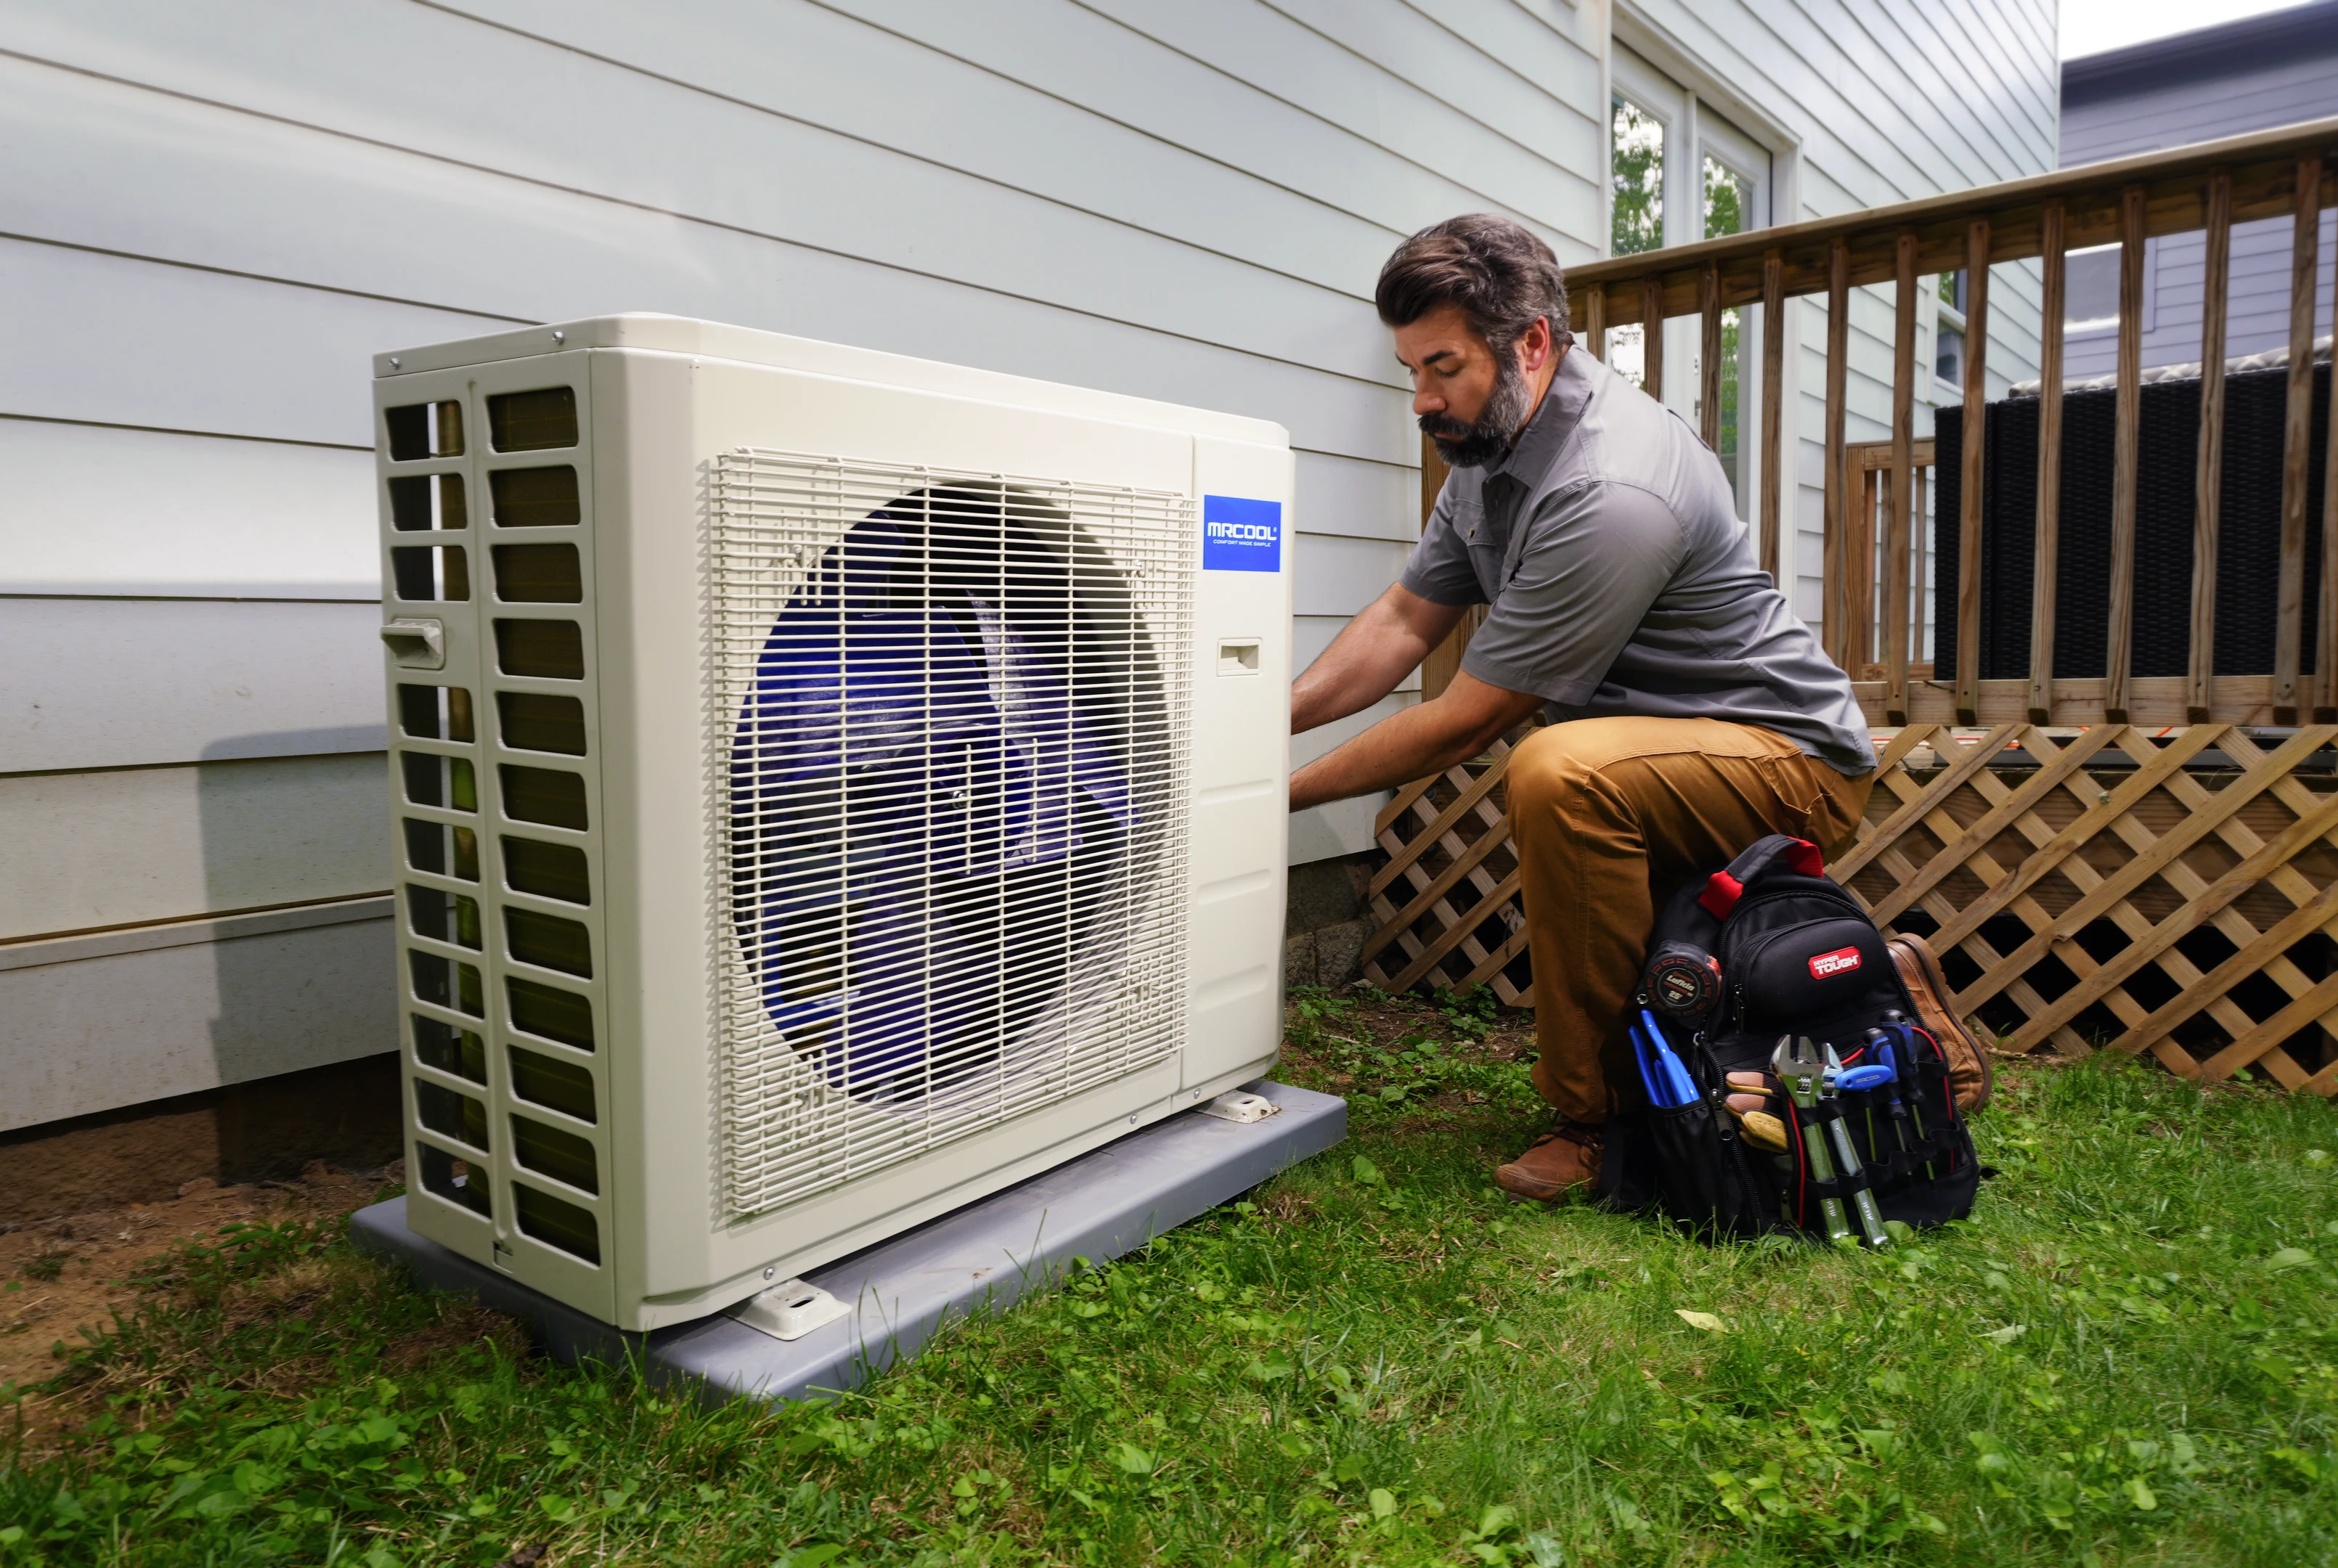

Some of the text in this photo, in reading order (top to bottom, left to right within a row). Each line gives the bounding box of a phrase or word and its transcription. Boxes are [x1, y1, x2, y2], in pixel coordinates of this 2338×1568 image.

[1813, 955, 1840, 967] HYPER
[1815, 955, 1859, 975] TOUGH
[1666, 975, 1695, 992] Lufkin
